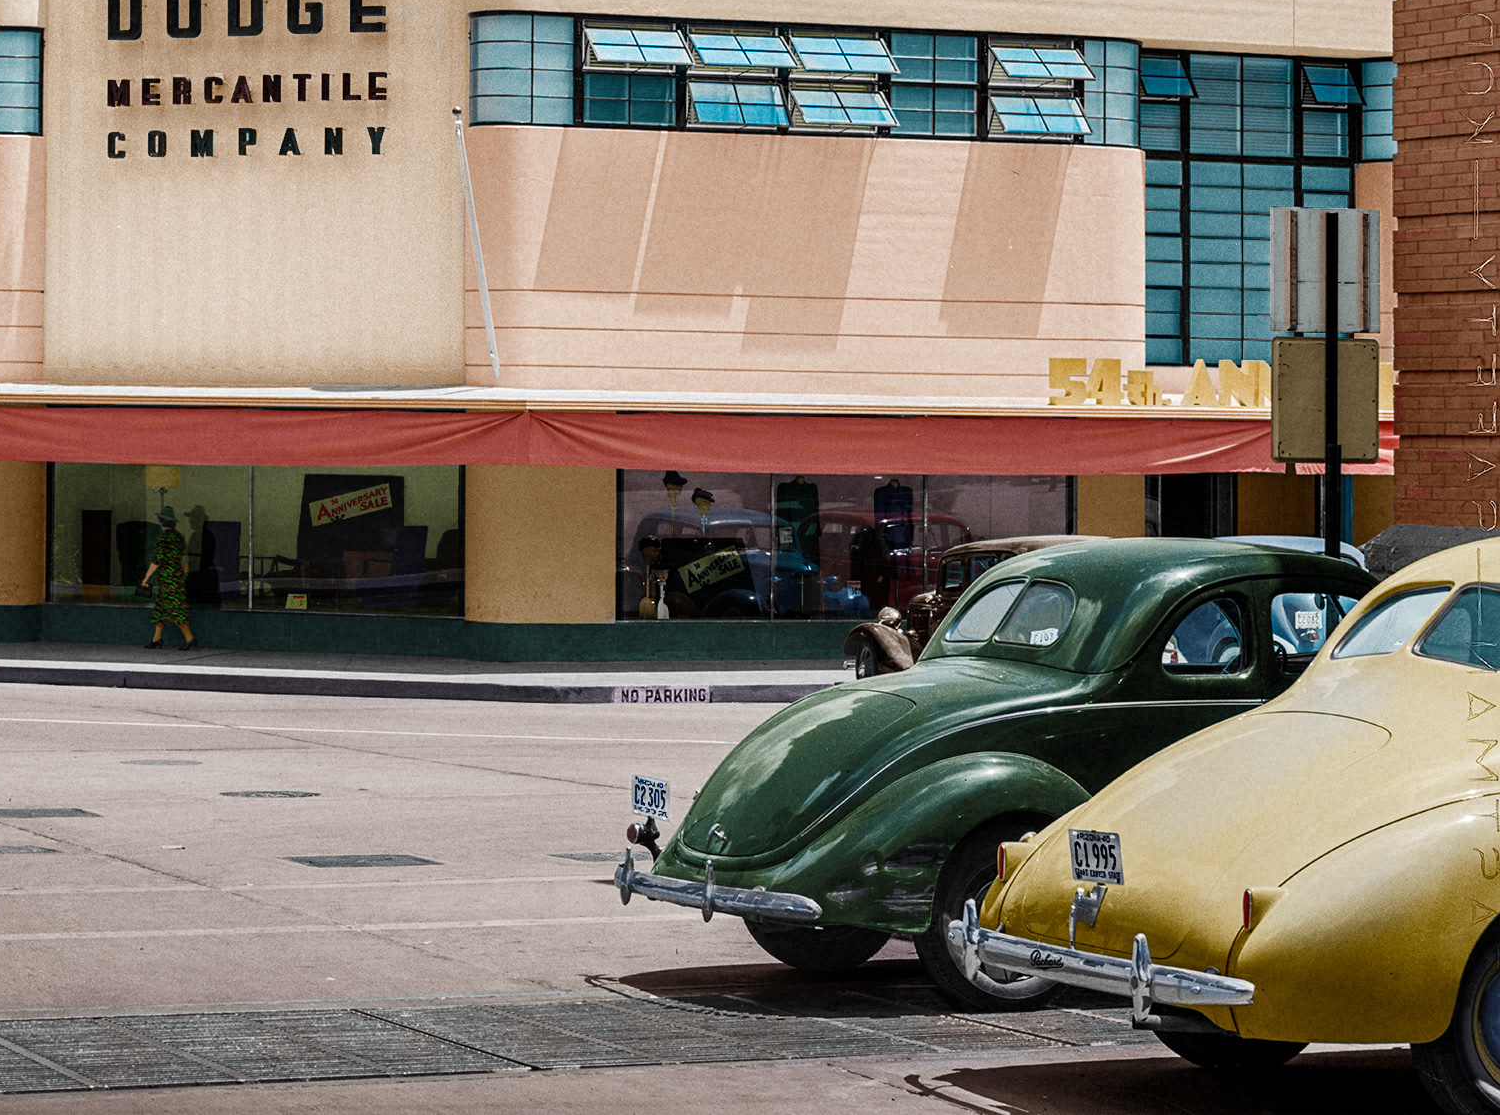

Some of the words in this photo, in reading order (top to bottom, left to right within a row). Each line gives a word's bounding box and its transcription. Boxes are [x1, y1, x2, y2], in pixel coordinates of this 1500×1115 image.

[107, 72, 388, 107] MERCANTILE
[107, 127, 386, 159] COMPANY
[317, 487, 388, 520] ANNIVERSARY
[360, 497, 388, 512] SALE
[718, 559, 740, 575] SALE
[621, 689, 639, 703] NO
[645, 688, 706, 703] PARKING
[1030, 950, 1064, 970] Packard
